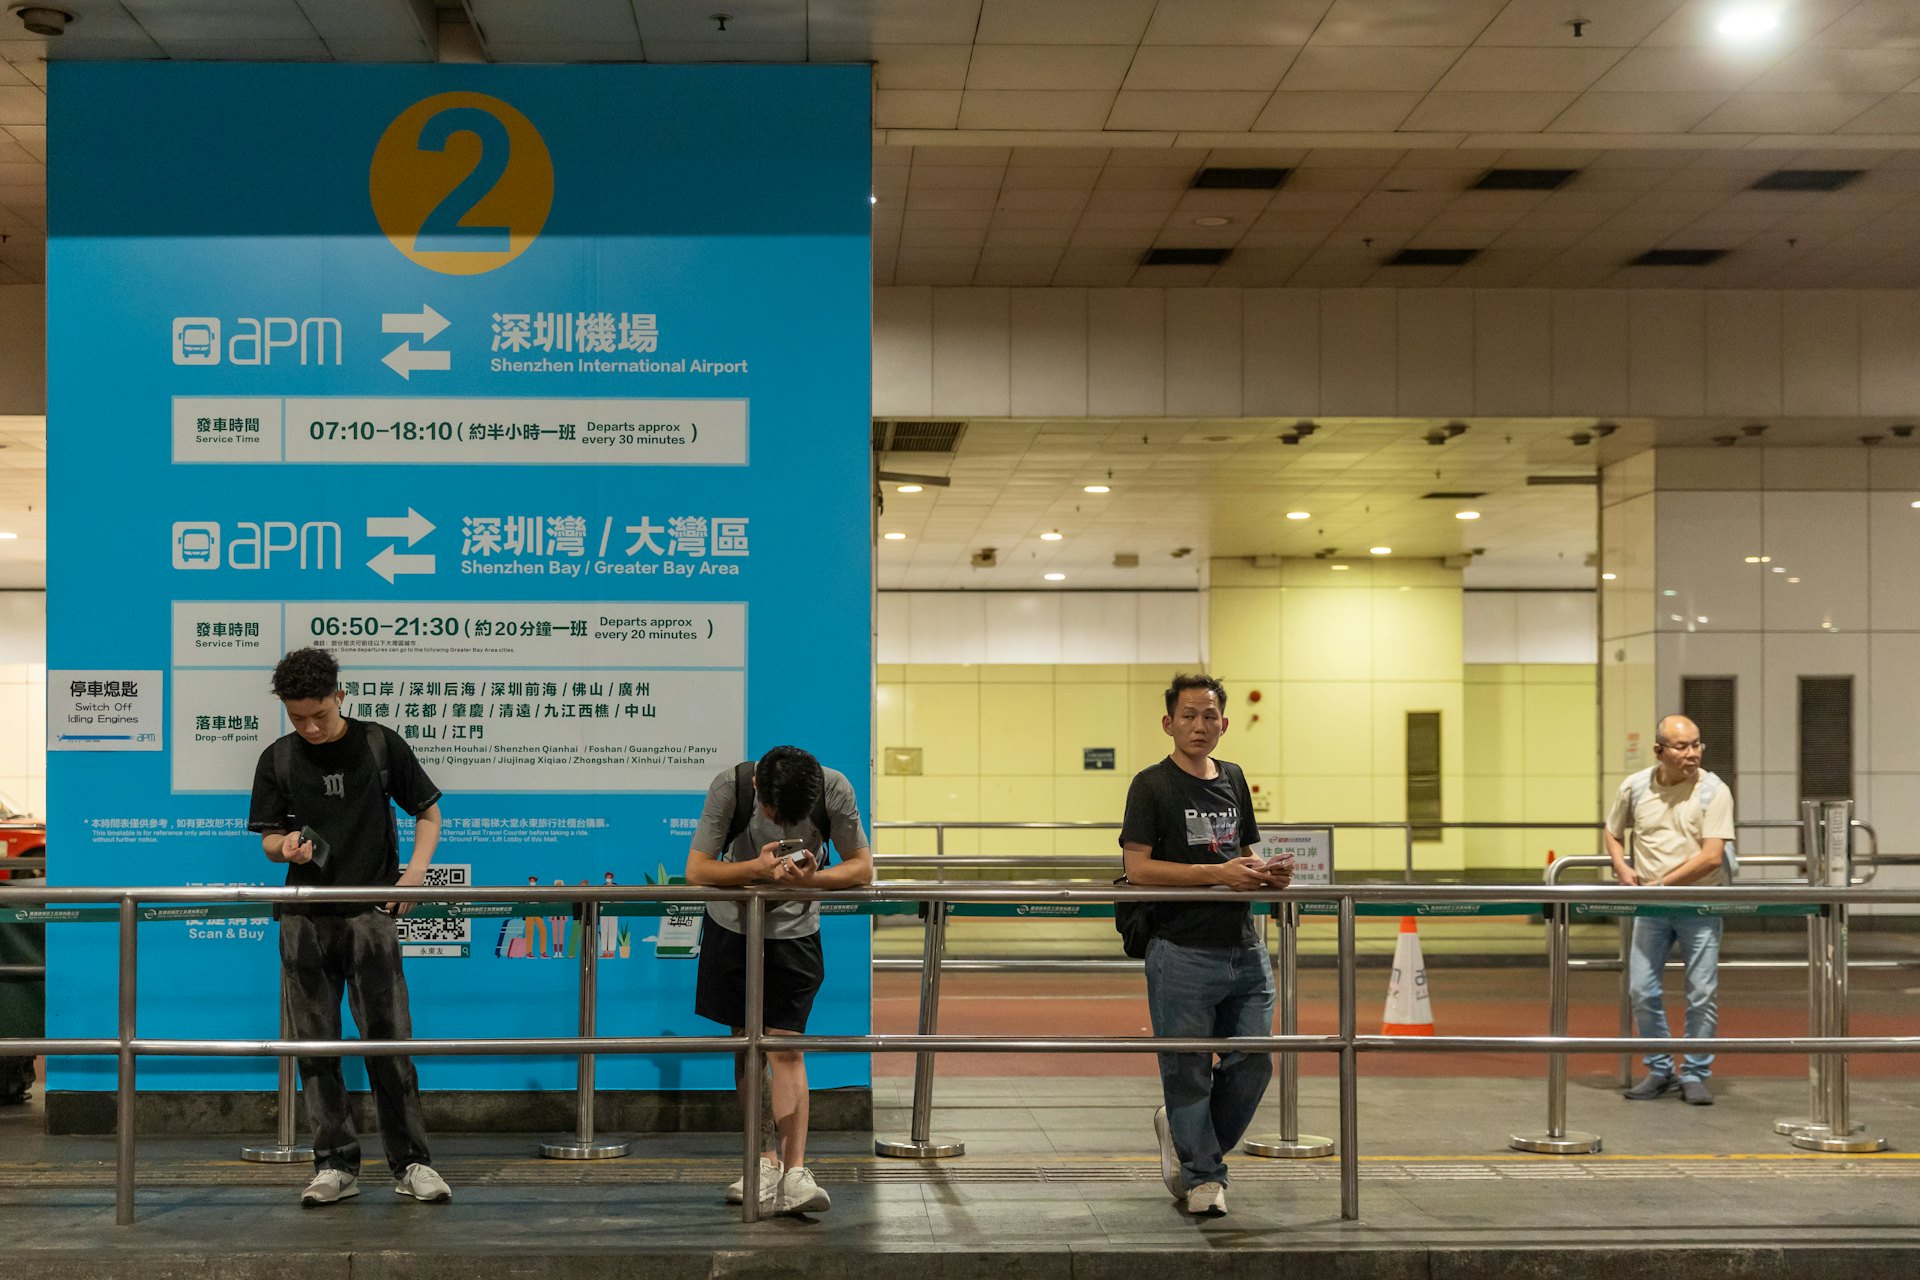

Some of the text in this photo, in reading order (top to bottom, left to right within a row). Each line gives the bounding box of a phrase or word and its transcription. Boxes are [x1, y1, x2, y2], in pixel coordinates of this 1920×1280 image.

[413, 107, 510, 252] 2
[490, 312, 658, 352] 深圳機場
[490, 358, 748, 376] Shenzhen International Airport
[197, 418, 260, 433] 發車時間
[587, 422, 680, 435] Departs approx
[196, 435, 260, 443] Service Time
[582, 435, 685, 446] every 30 minutes
[461, 515, 586, 556] 深圳灣
[625, 516, 750, 557] 大灣區
[461, 560, 544, 575] Shenzhen
[550, 561, 582, 577] Bay
[594, 561, 658, 575] Greater
[664, 562, 695, 577] Bay
[699, 562, 739, 575] Area
[196, 622, 260, 637] 發車時間
[599, 617, 692, 629] Departs approx
[594, 630, 697, 642] every 20 minutes
[195, 640, 260, 648] Service Time
[70, 680, 138, 698] 停車熄匙
[409, 682, 476, 697] 深圳后海
[491, 682, 557, 697] 深圳前海
[572, 682, 603, 697] 佛山
[618, 683, 650, 697] 廣州
[75, 702, 132, 711] Switch Off
[358, 703, 390, 718] 順德
[405, 703, 437, 718] 花都
[452, 704, 484, 718] 肇慶
[499, 704, 531, 718] 清遠
[544, 704, 609, 718] 九江西樵
[625, 704, 656, 718] 中山
[68, 714, 139, 724] Idling Engines
[195, 715, 259, 730] 落車地點
[195, 733, 258, 743] Drop-off point
[405, 725, 436, 739] 鶴山
[452, 725, 484, 739] 江門
[454, 745, 487, 753] Houhai
[494, 745, 540, 753] Shenzhen
[542, 745, 578, 753] Qianhai
[589, 745, 622, 753] Foshan
[629, 745, 681, 754] Guangzhou
[688, 746, 717, 754] Panyu
[447, 756, 491, 765] Qingyuan
[537, 756, 567, 765] Xiqiao
[573, 757, 625, 765] Zhongshan
[189, 928, 264, 941] Scan & Buy
[420, 947, 444, 955] 永東友
